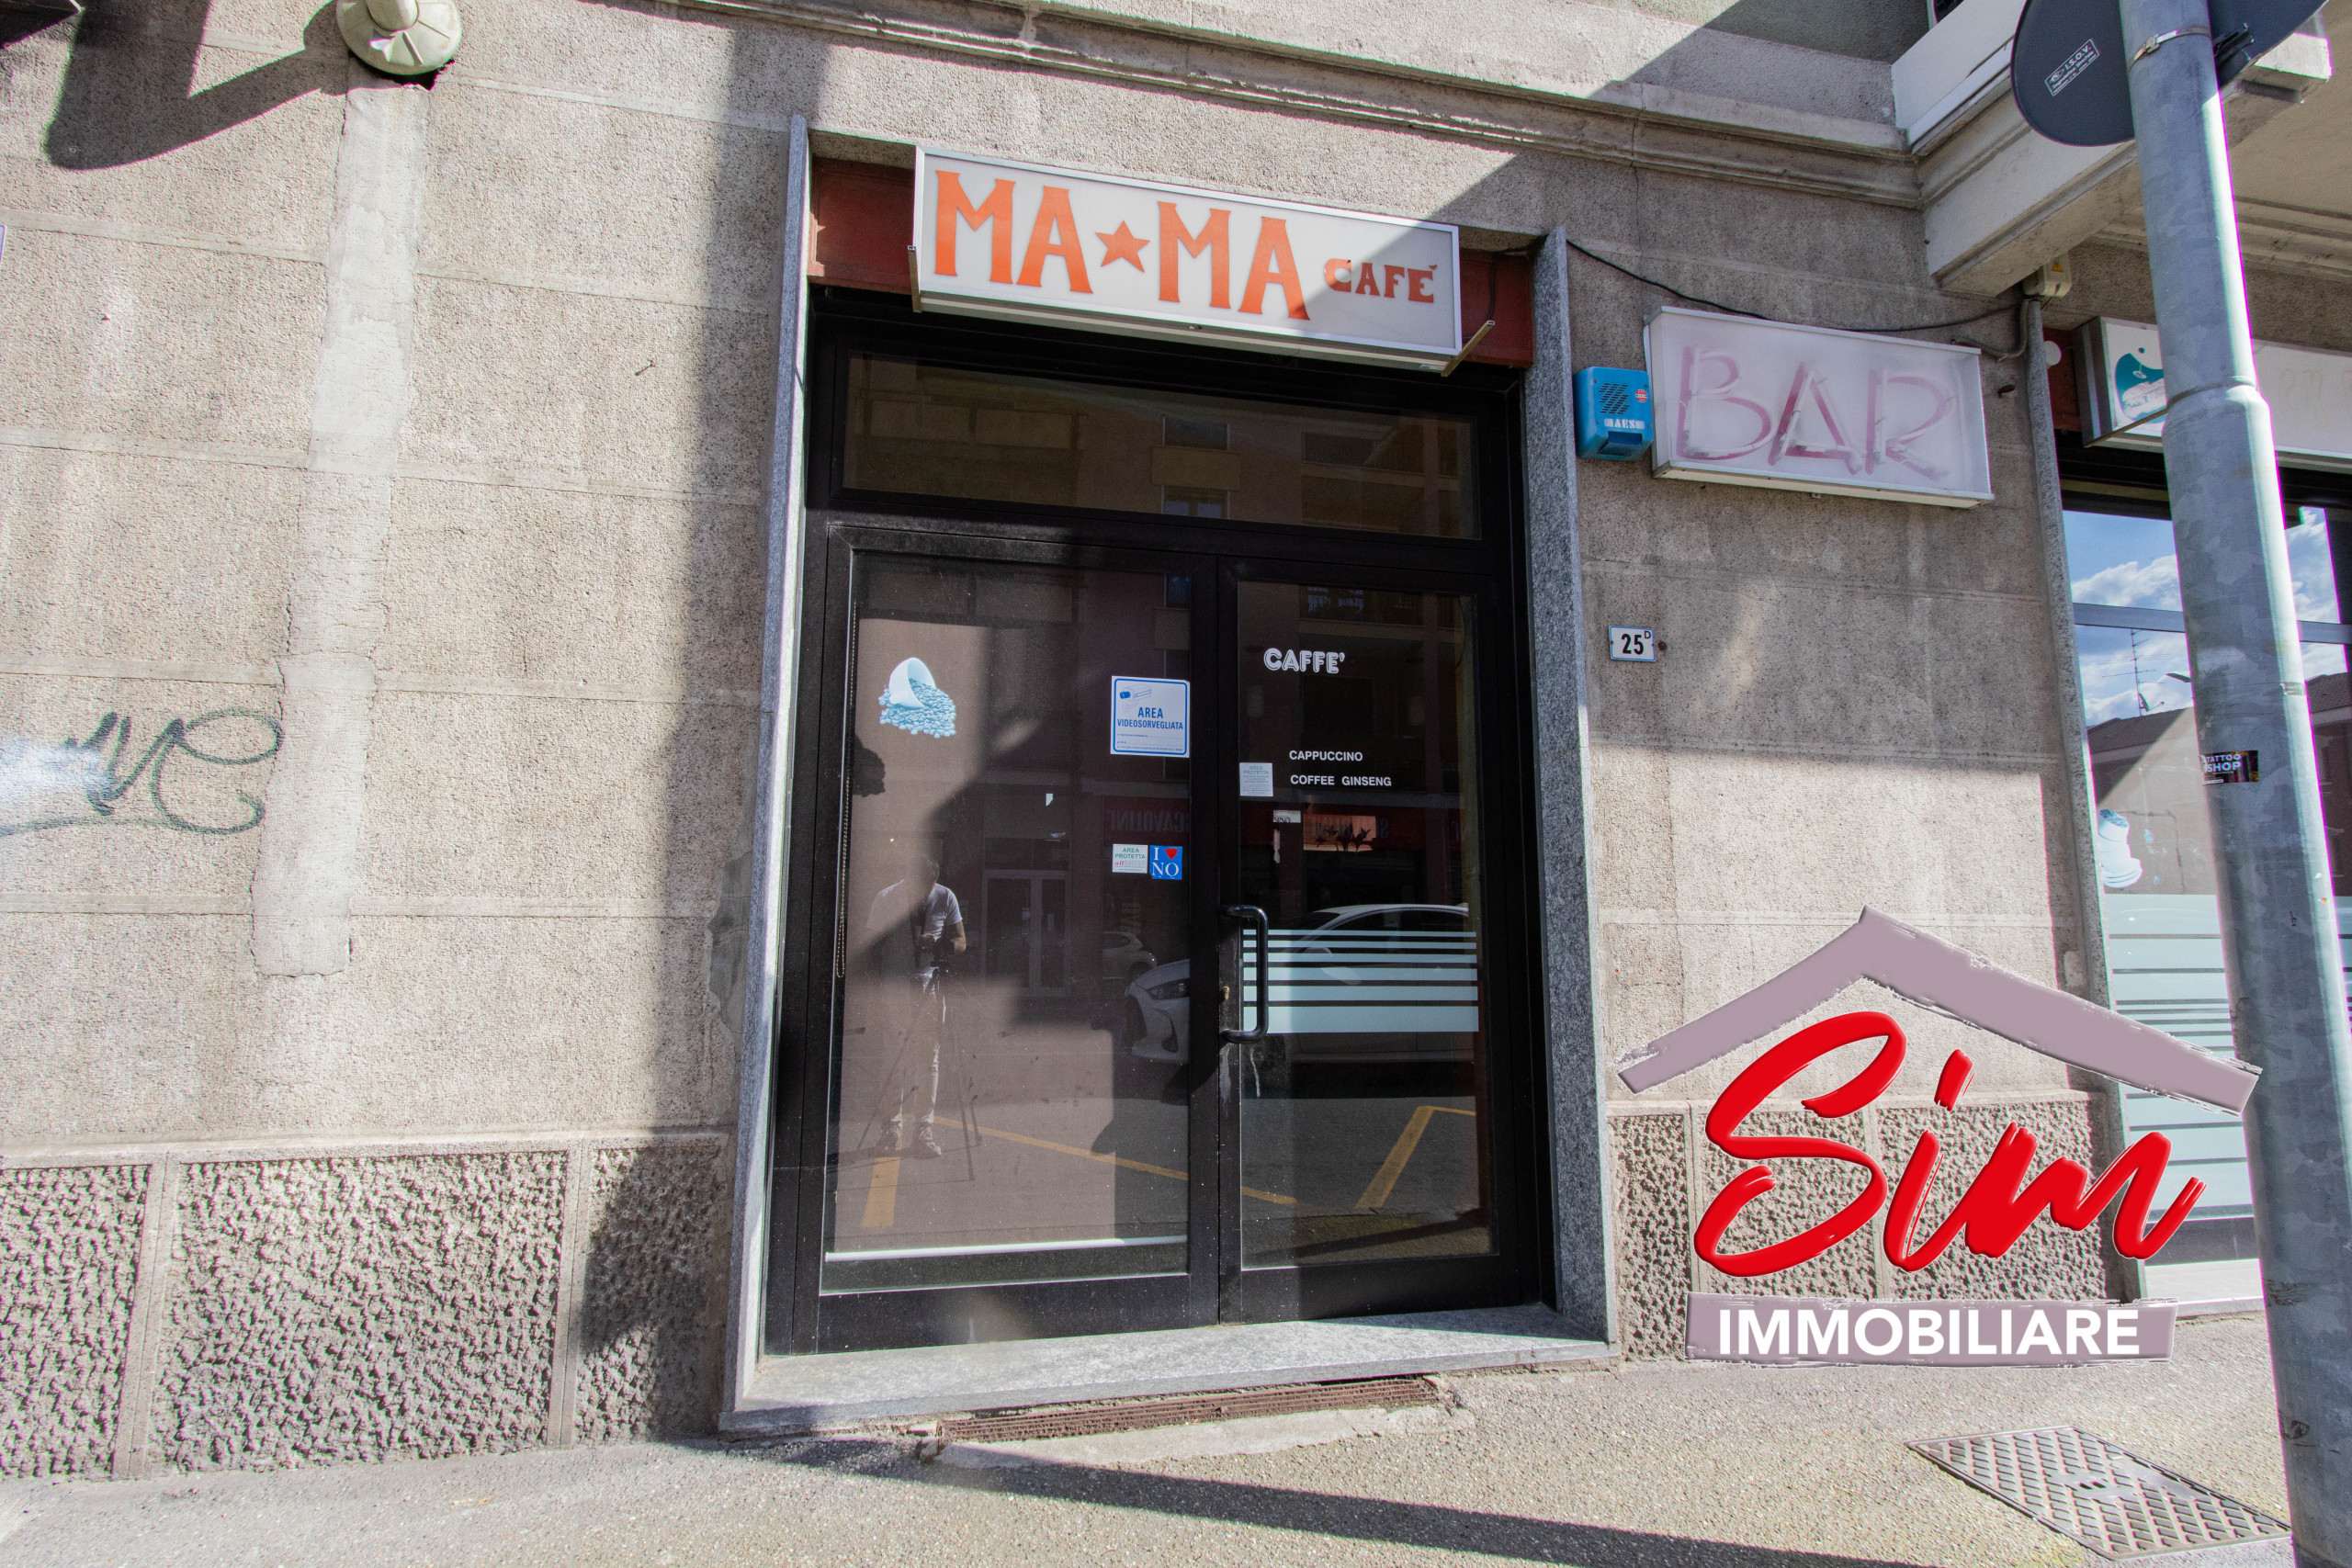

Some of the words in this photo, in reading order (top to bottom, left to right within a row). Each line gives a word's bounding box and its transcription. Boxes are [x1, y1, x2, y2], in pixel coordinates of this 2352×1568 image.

[1676, 345, 1956, 481] BAR
[1614, 418, 1635, 429] AES
[1137, 706, 1163, 718] AREA
[1117, 718, 1183, 730] VIDEOSORVEGLIATA
[1289, 750, 1363, 761] CAPPUCCINO
[2207, 753, 2242, 763] TATTOO
[2207, 761, 2242, 773] SHOP
[1290, 774, 1335, 785] COFFEE
[1341, 775, 1392, 787] GINSENG
[1153, 847, 1159, 861] I
